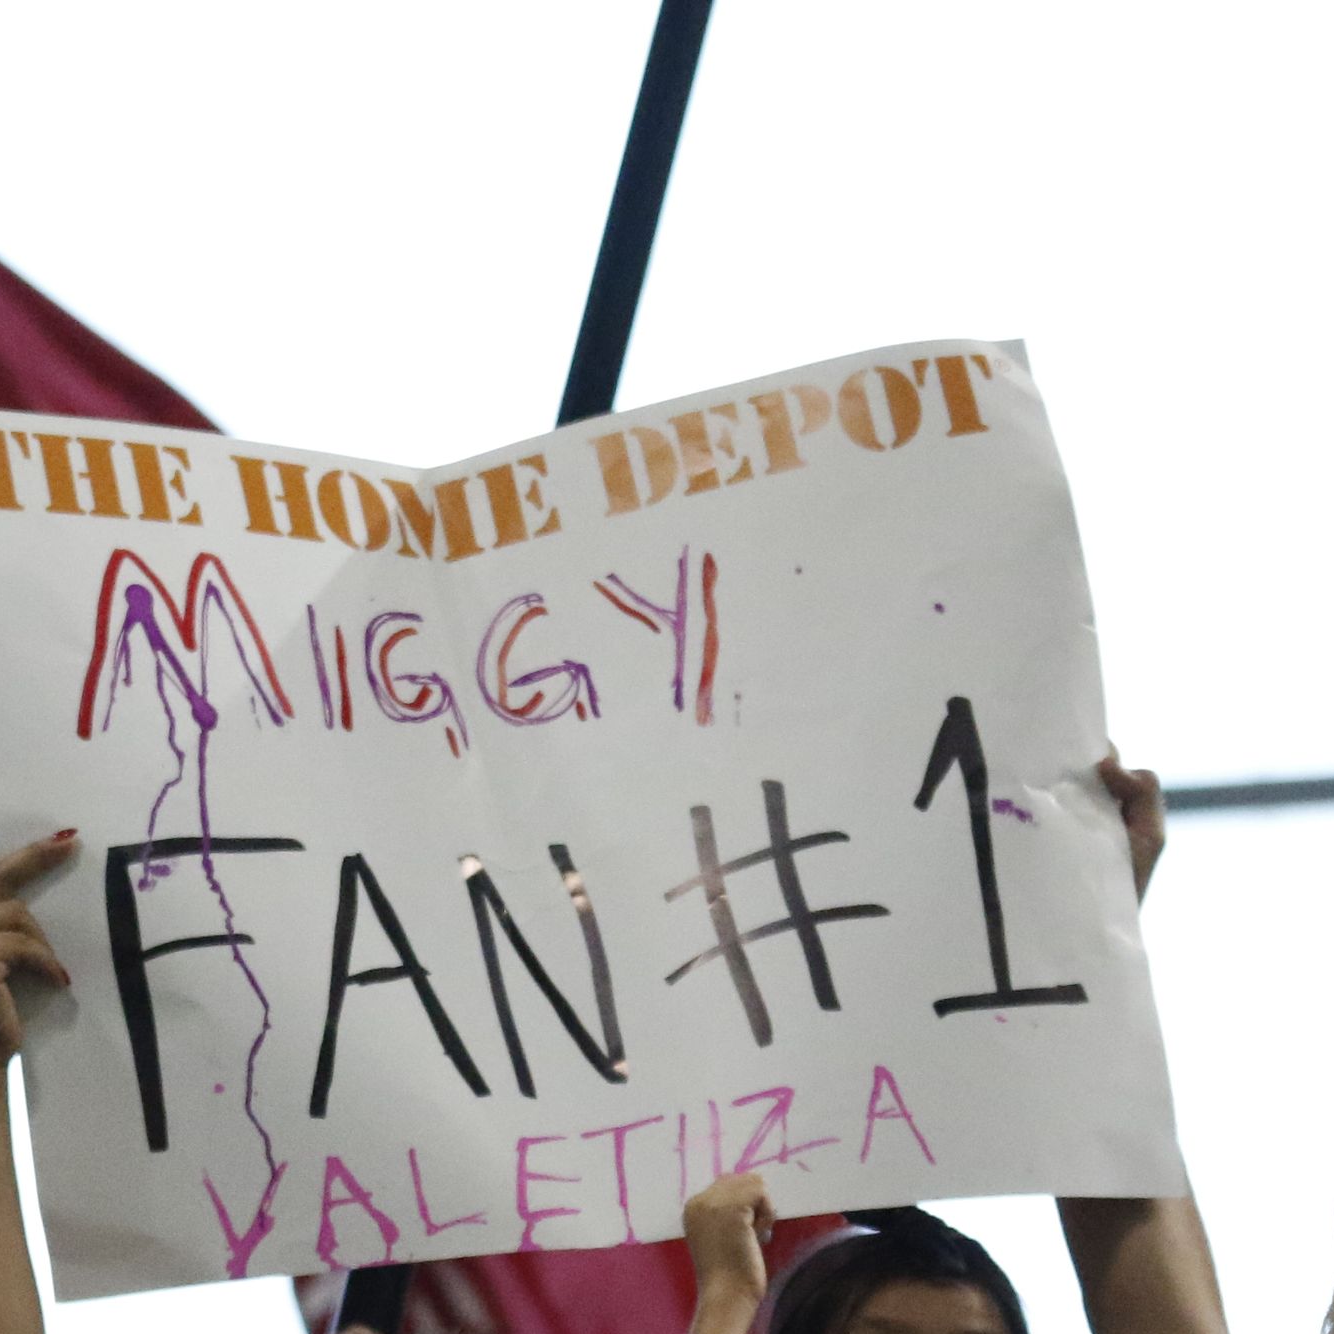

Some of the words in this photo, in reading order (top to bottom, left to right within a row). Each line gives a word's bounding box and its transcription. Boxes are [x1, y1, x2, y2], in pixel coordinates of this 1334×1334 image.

[230, 454, 561, 562] HOME
[589, 354, 993, 517] DEPOT
[105, 838, 628, 1151] FAN
